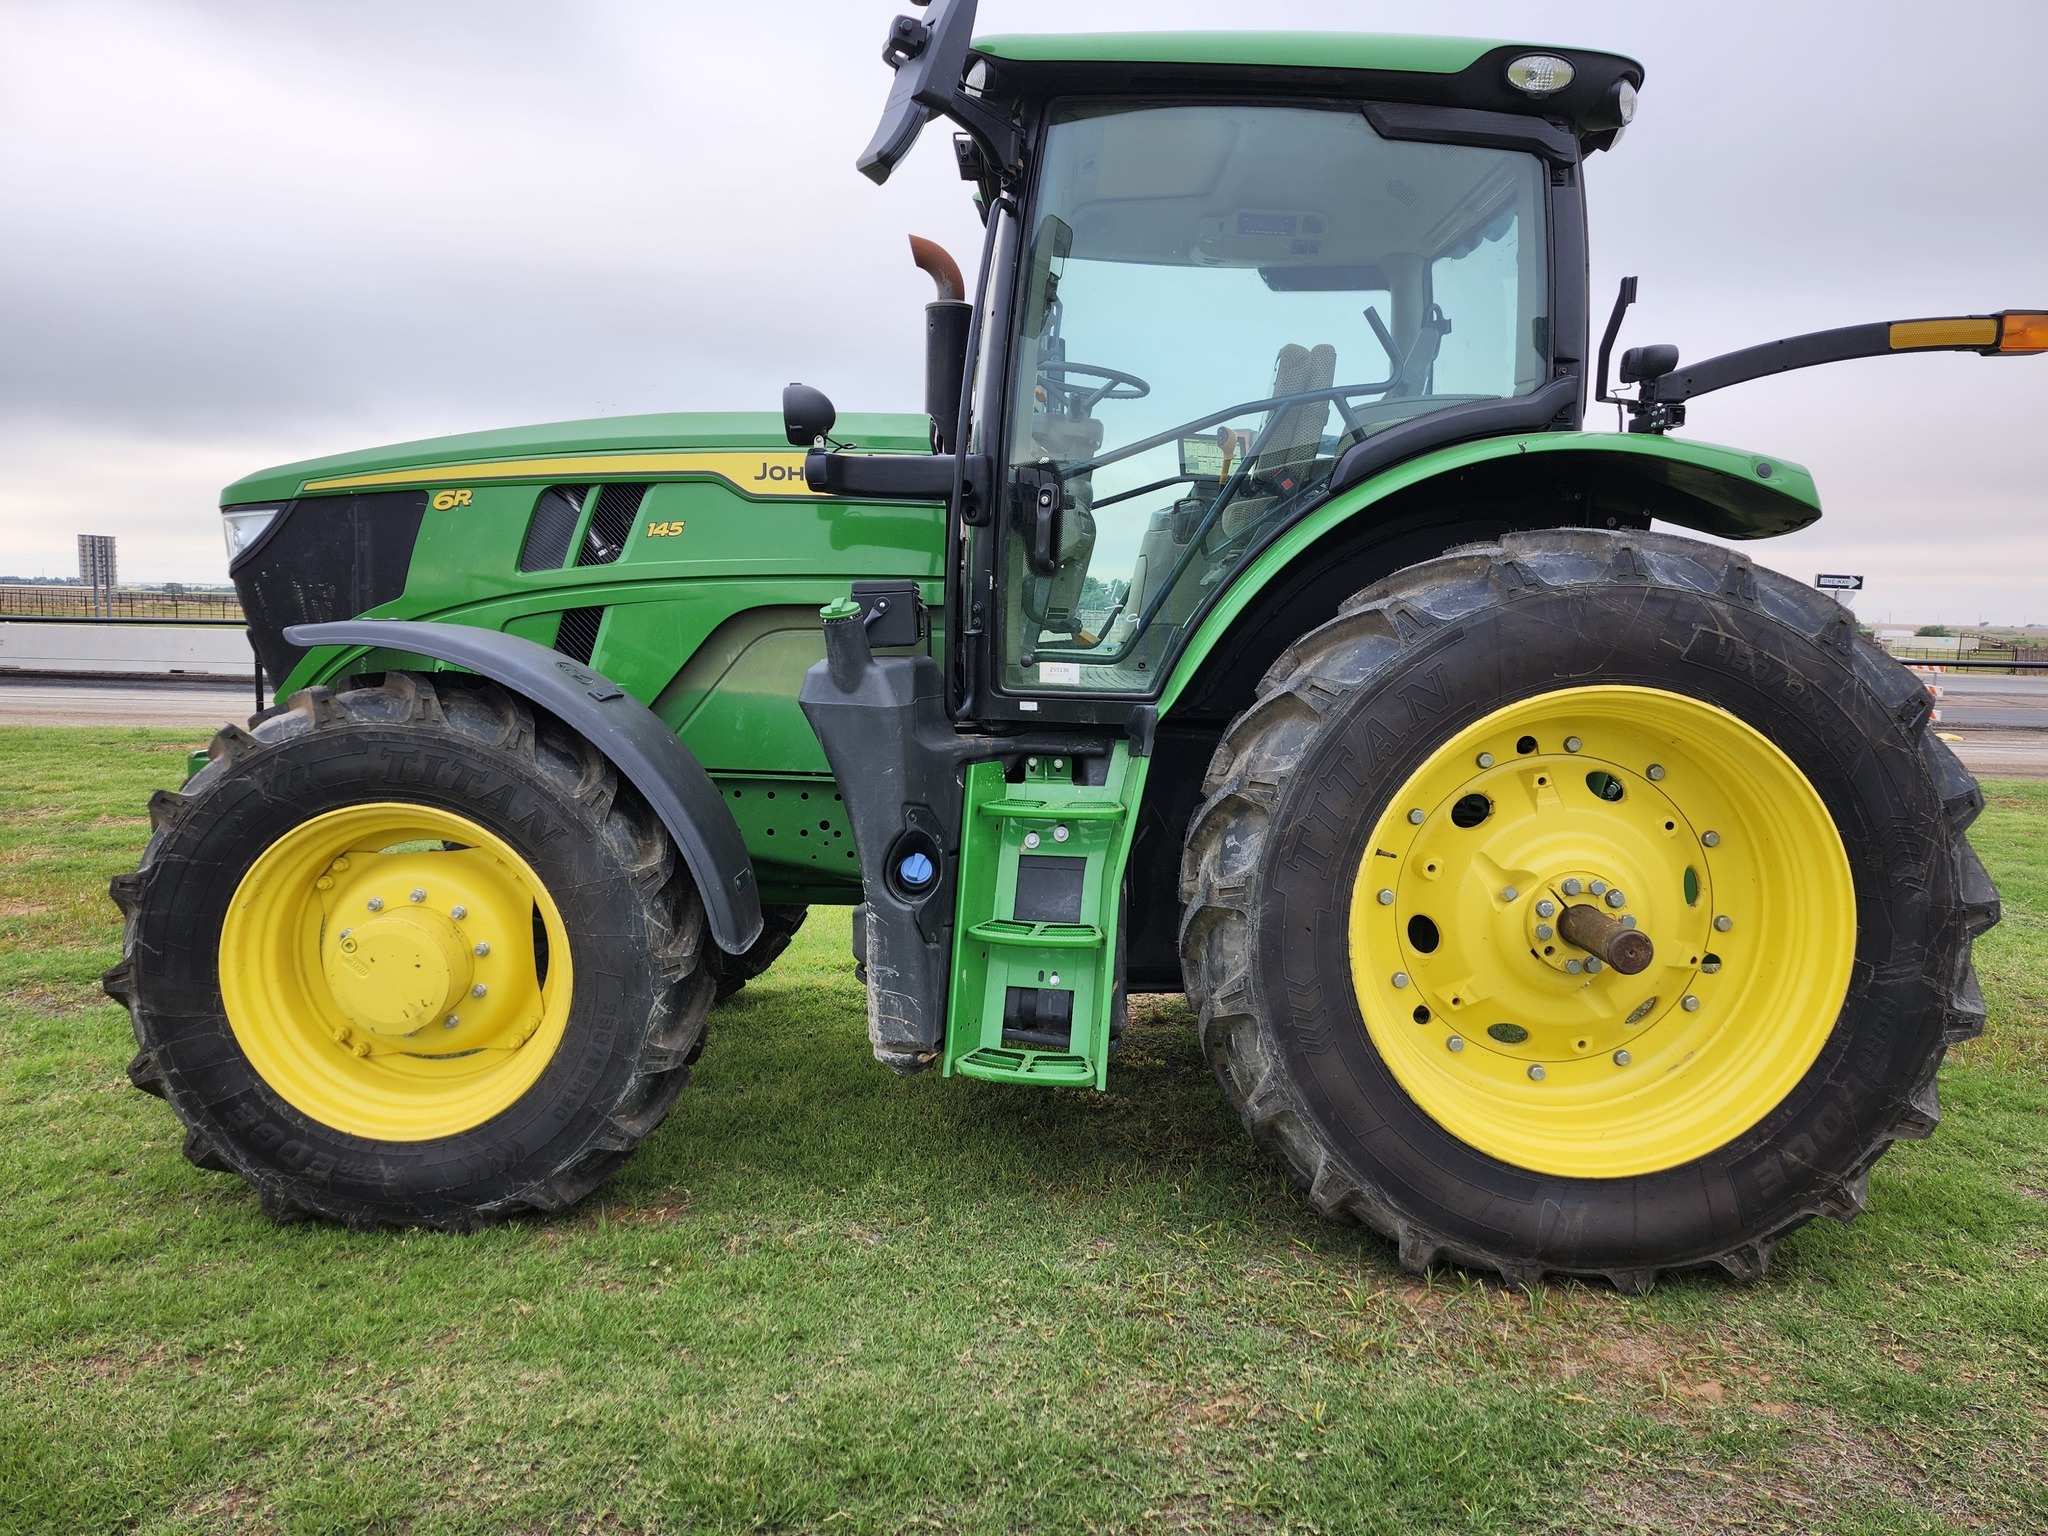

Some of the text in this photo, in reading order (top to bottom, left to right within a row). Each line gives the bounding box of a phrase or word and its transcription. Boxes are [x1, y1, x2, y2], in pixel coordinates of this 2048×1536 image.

[753, 462, 805, 481] JOH
[432, 489, 473, 511] 6R
[647, 521, 686, 537] 145
[1283, 662, 1446, 880] TITAN
[378, 746, 570, 847] TITAN
